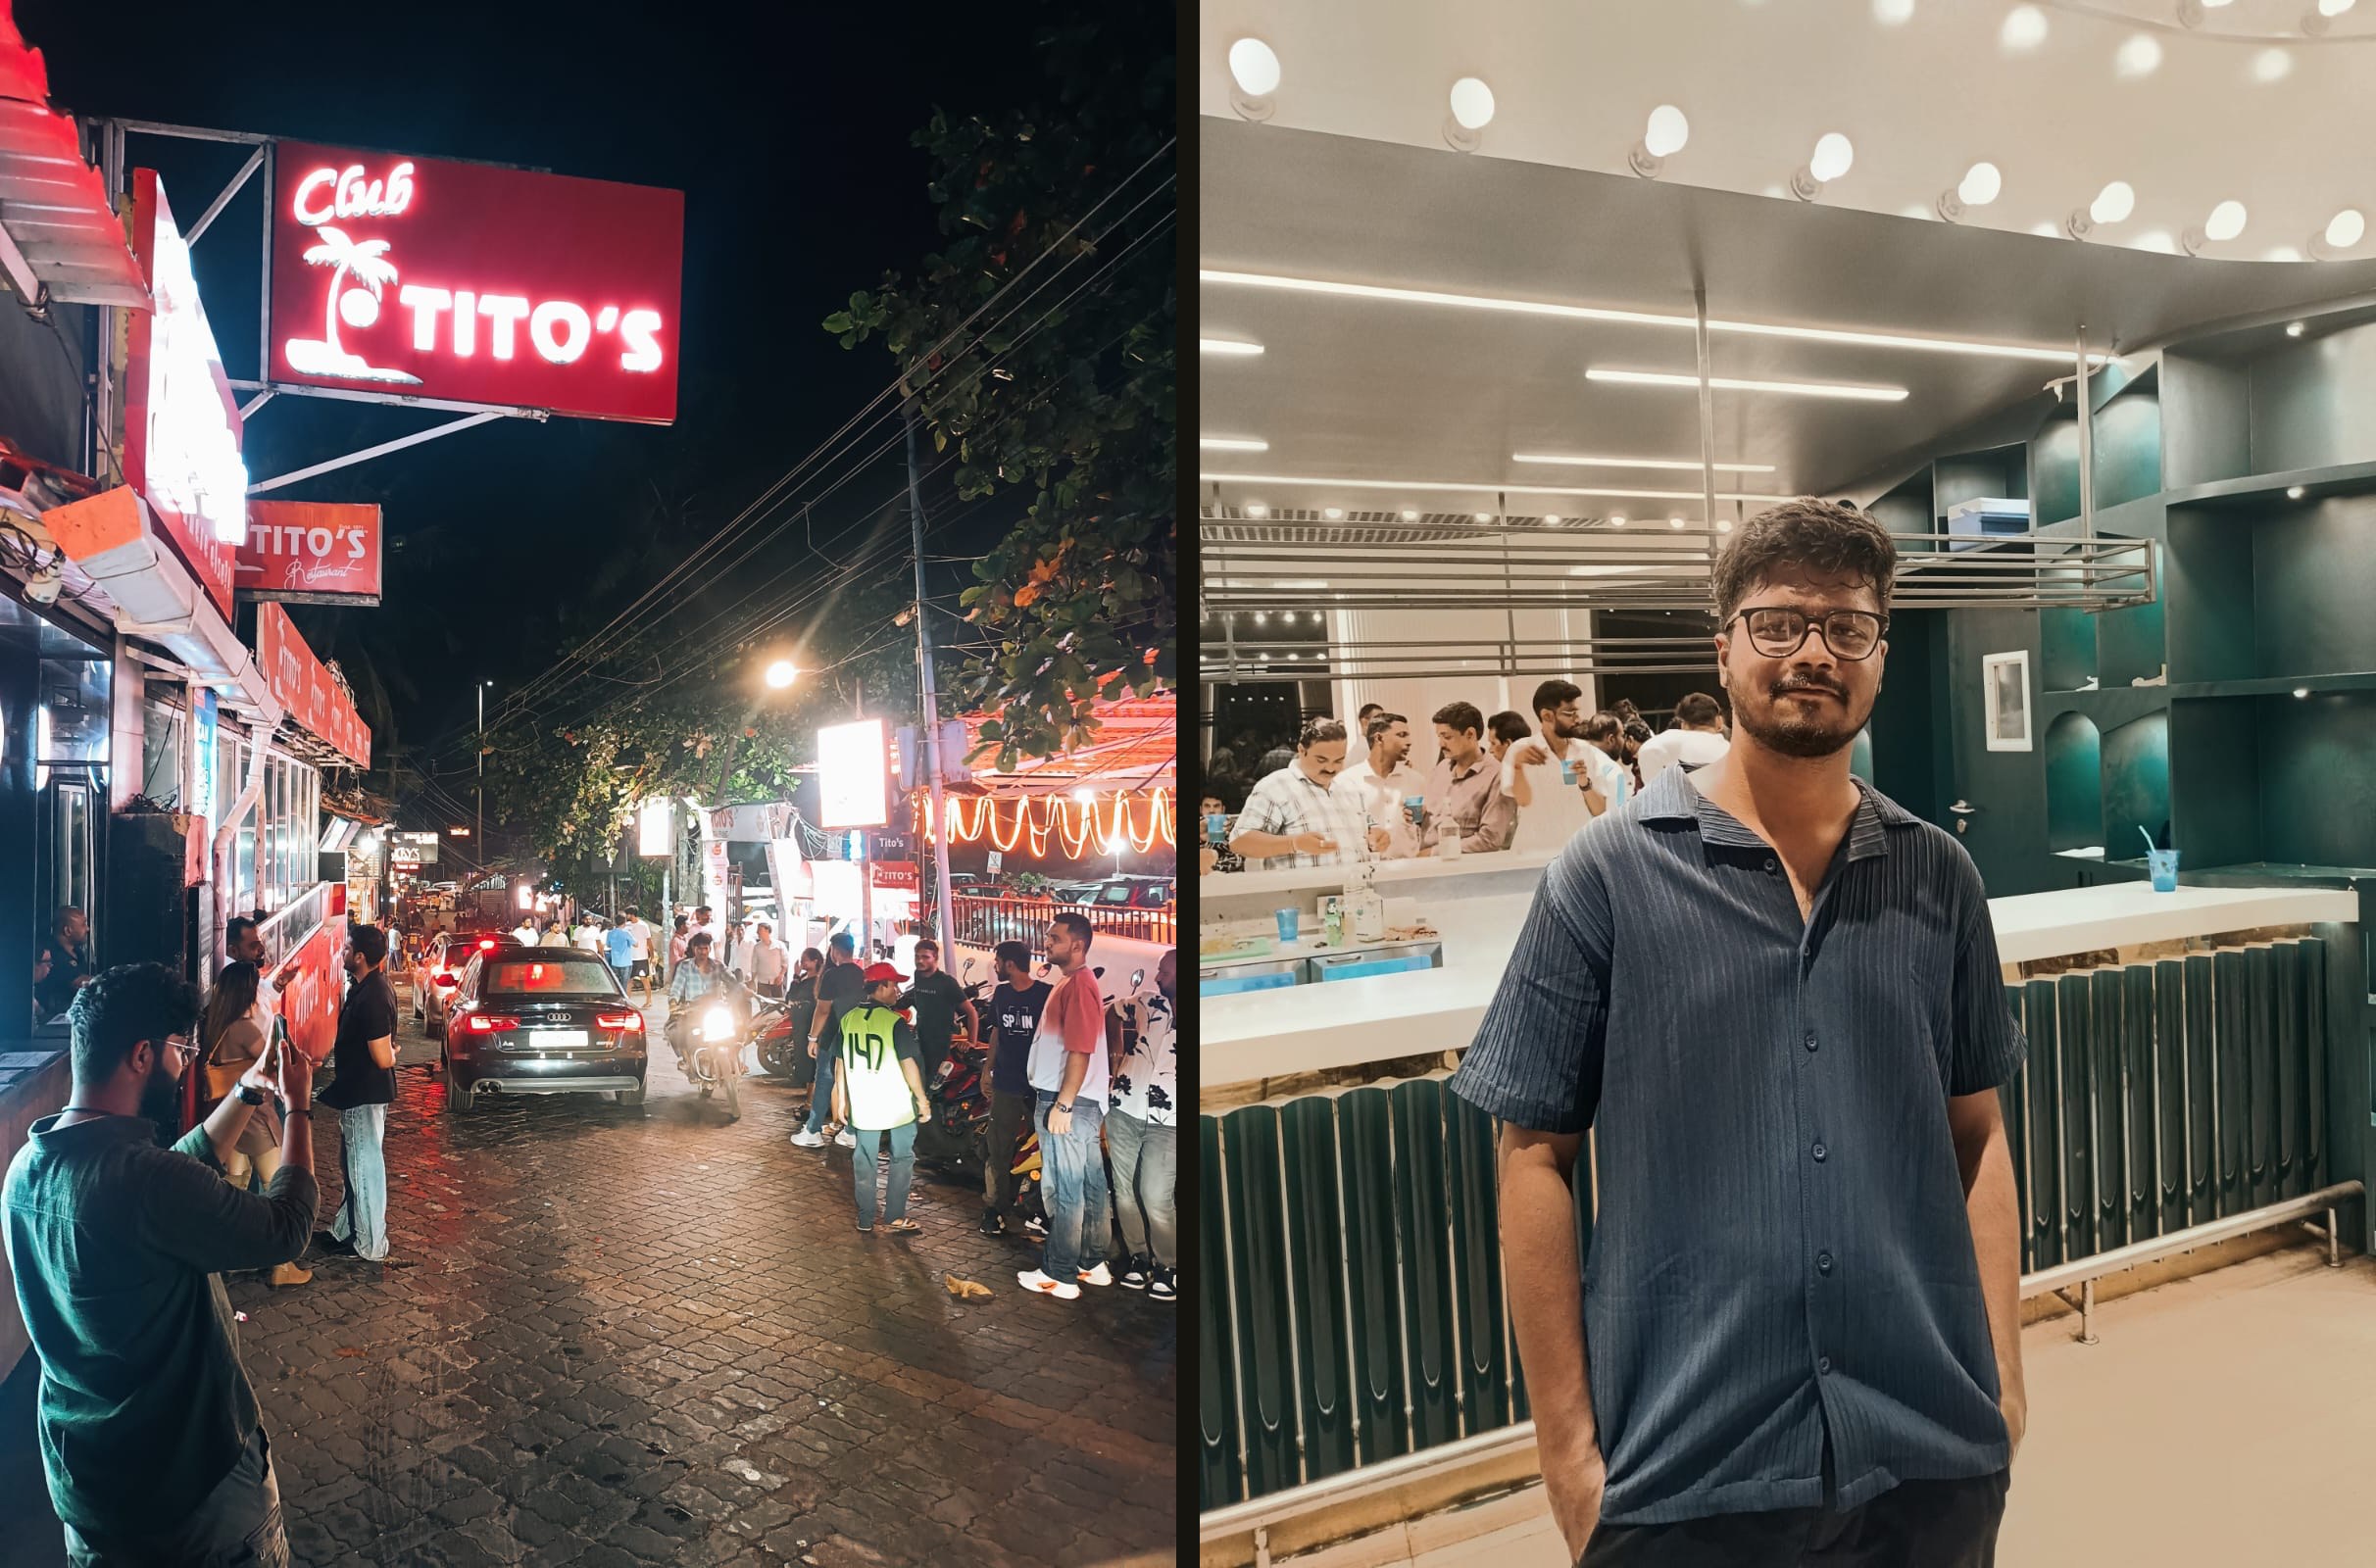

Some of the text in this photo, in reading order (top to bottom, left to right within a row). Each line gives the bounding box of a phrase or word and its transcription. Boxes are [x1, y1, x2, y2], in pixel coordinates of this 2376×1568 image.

[294, 162, 415, 226] Club
[400, 284, 663, 372] TITO'S
[249, 524, 366, 559] TITO'S
[284, 558, 364, 589] Restaurant
[879, 838, 904, 847] Tito's
[884, 871, 914, 880] TITO'S
[1003, 1010, 1033, 1029] SPAIN
